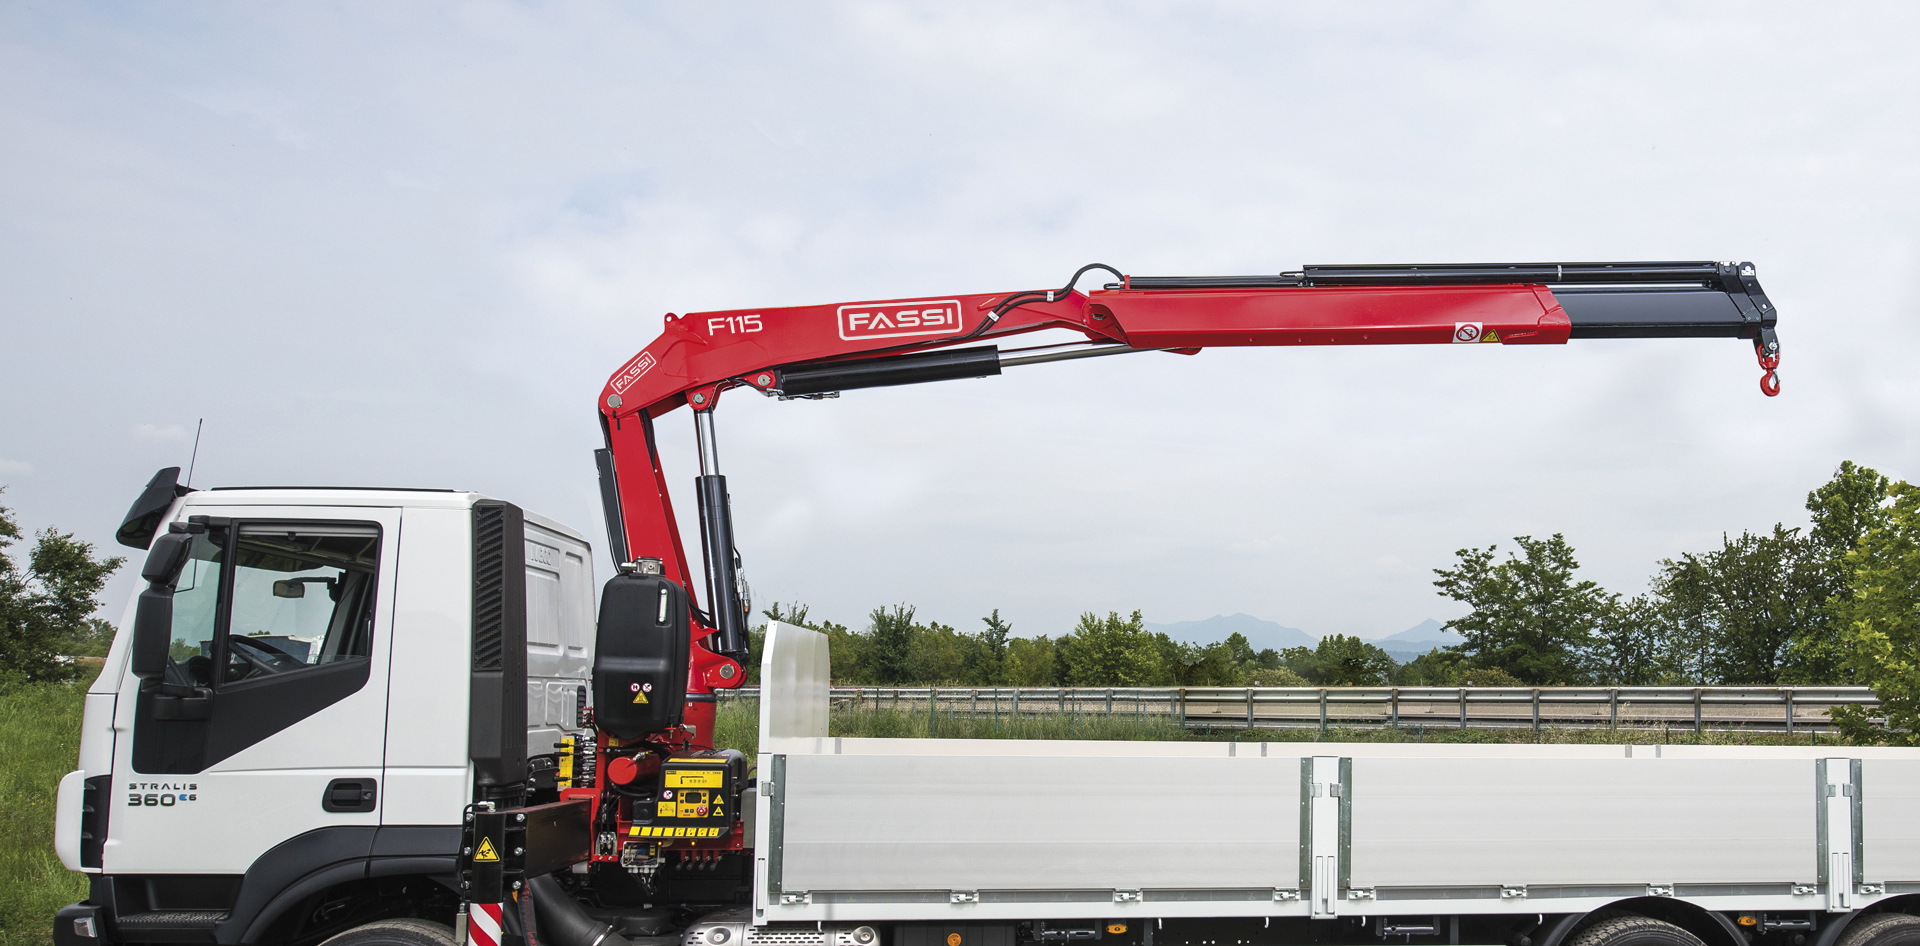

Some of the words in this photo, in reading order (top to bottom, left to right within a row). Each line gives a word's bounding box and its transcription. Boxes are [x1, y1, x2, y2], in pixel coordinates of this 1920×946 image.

[706, 313, 764, 337] F115
[848, 307, 954, 332] FASSI
[615, 356, 652, 390] FASSI
[128, 782, 198, 791] STRALIS
[127, 793, 176, 807] 360
